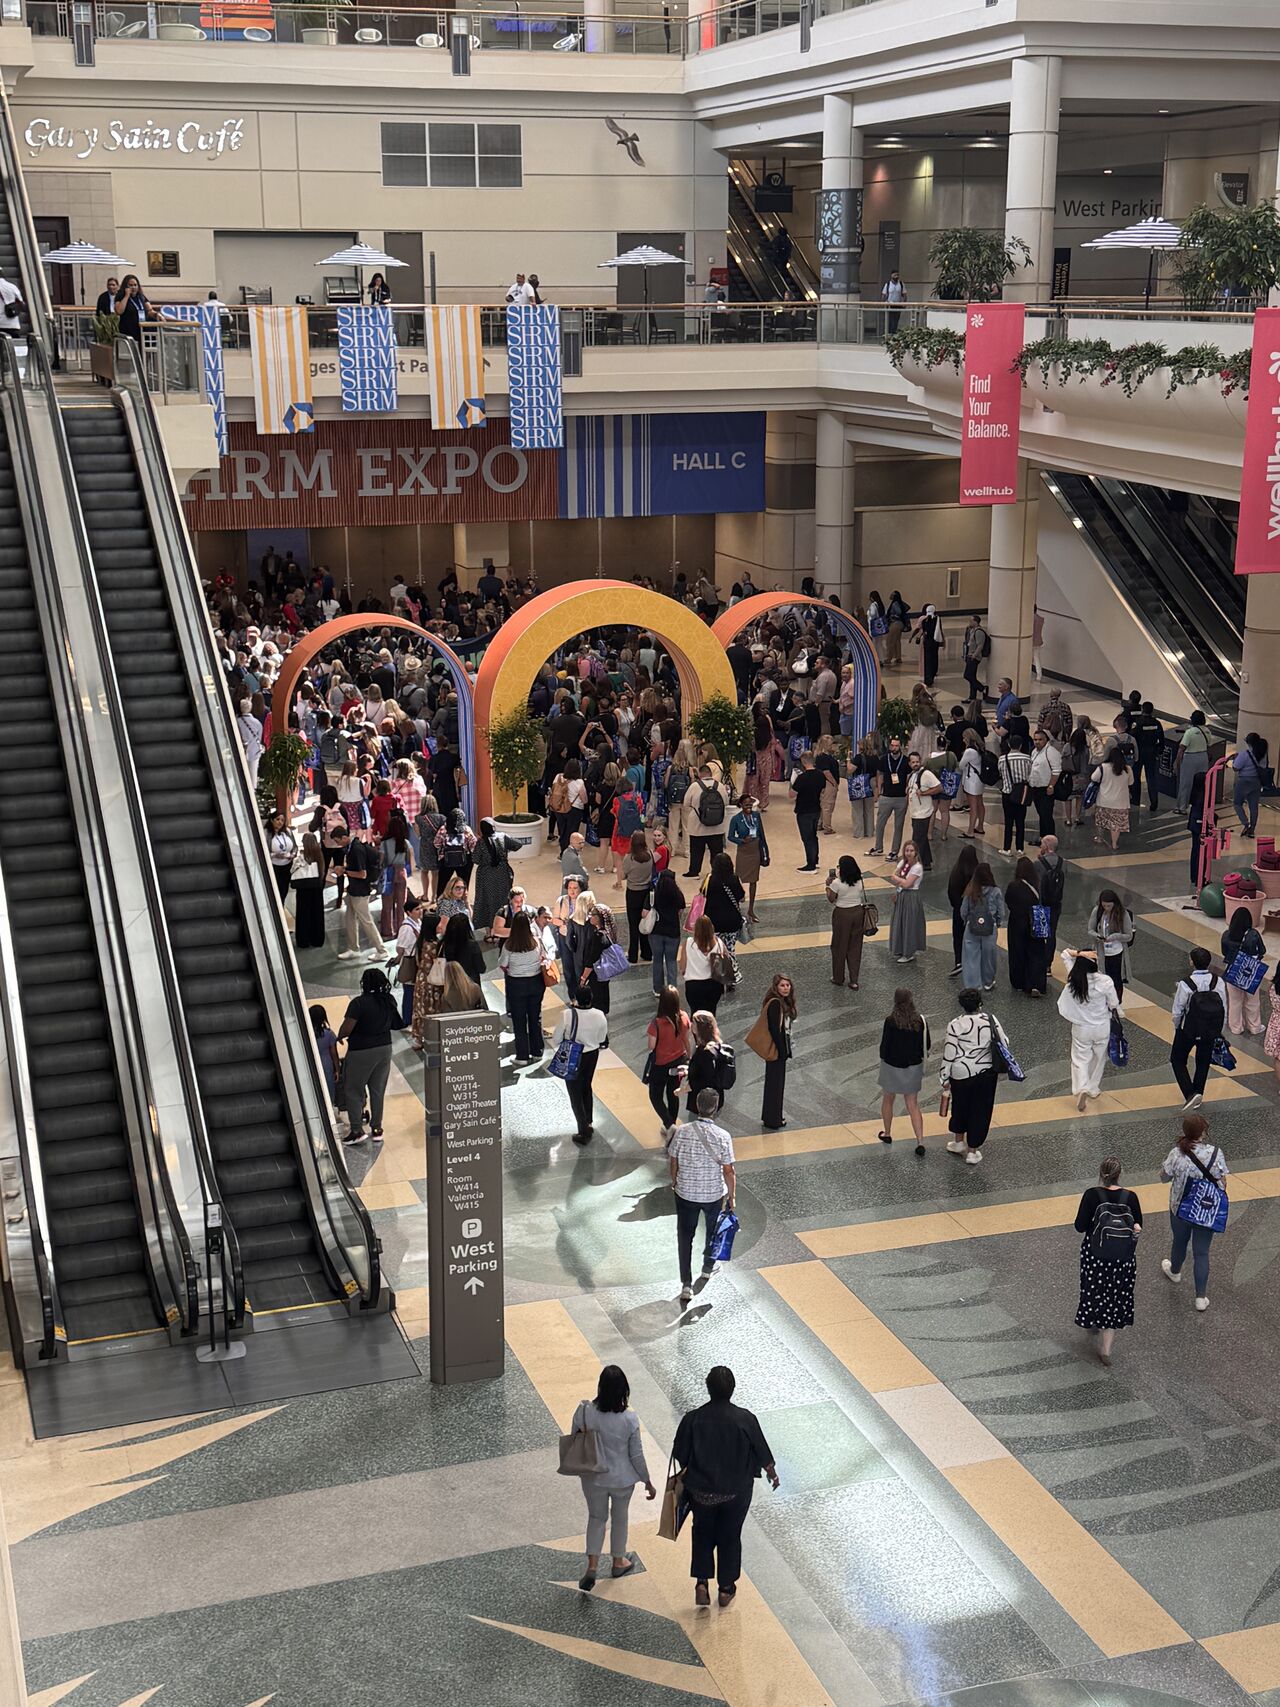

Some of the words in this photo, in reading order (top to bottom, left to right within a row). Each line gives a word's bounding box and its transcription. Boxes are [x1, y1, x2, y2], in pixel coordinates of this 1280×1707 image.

[25, 118, 98, 159] Gary
[103, 120, 171, 151] Sain
[177, 118, 243, 161] Café
[1063, 200, 1105, 217] West
[337, 305, 393, 326] SHRM
[507, 304, 560, 325] SHRM
[338, 327, 395, 347] SHRM
[508, 325, 561, 345] SHRM
[340, 348, 396, 368] SHRM
[508, 346, 561, 366] SHRM
[341, 369, 397, 389] SHRM
[509, 366, 562, 387] SHRM
[969, 374, 991, 393] Find
[342, 390, 398, 411] SHRM
[510, 387, 563, 407] SHRM
[969, 397, 991, 416] Your
[511, 407, 563, 428] SHRM
[511, 428, 564, 448] SHRM
[968, 420, 1010, 438] Balance.
[673, 452, 726, 471] HALL
[731, 451, 746, 469] C
[356, 445, 528, 496] EXPO
[963, 486, 1013, 496] wellhub
[445, 1025, 483, 1036] Skybridge
[442, 1037, 463, 1046] Hyatt
[464, 1034, 496, 1044] Regency
[445, 1052, 470, 1063] Level
[473, 1052, 479, 1060] 3
[445, 1074, 474, 1083] Rooms
[453, 1082, 480, 1092] W314-
[453, 1091, 478, 1101] W315
[446, 1102, 471, 1112] Chapin
[472, 1099, 497, 1108] Theater
[453, 1110, 478, 1119] W320
[443, 1122, 461, 1130] Gary
[463, 1119, 479, 1128] Sain
[480, 1116, 497, 1126] Café
[447, 1140, 466, 1149] West
[466, 1137, 494, 1146] Parking
[447, 1153, 472, 1164] Level
[447, 1175, 472, 1184] Room
[454, 1182, 480, 1192] W414
[448, 1191, 484, 1202] Valencia
[454, 1200, 480, 1211] W415
[450, 1240, 495, 1259] West
[449, 1259, 498, 1275] Parking
